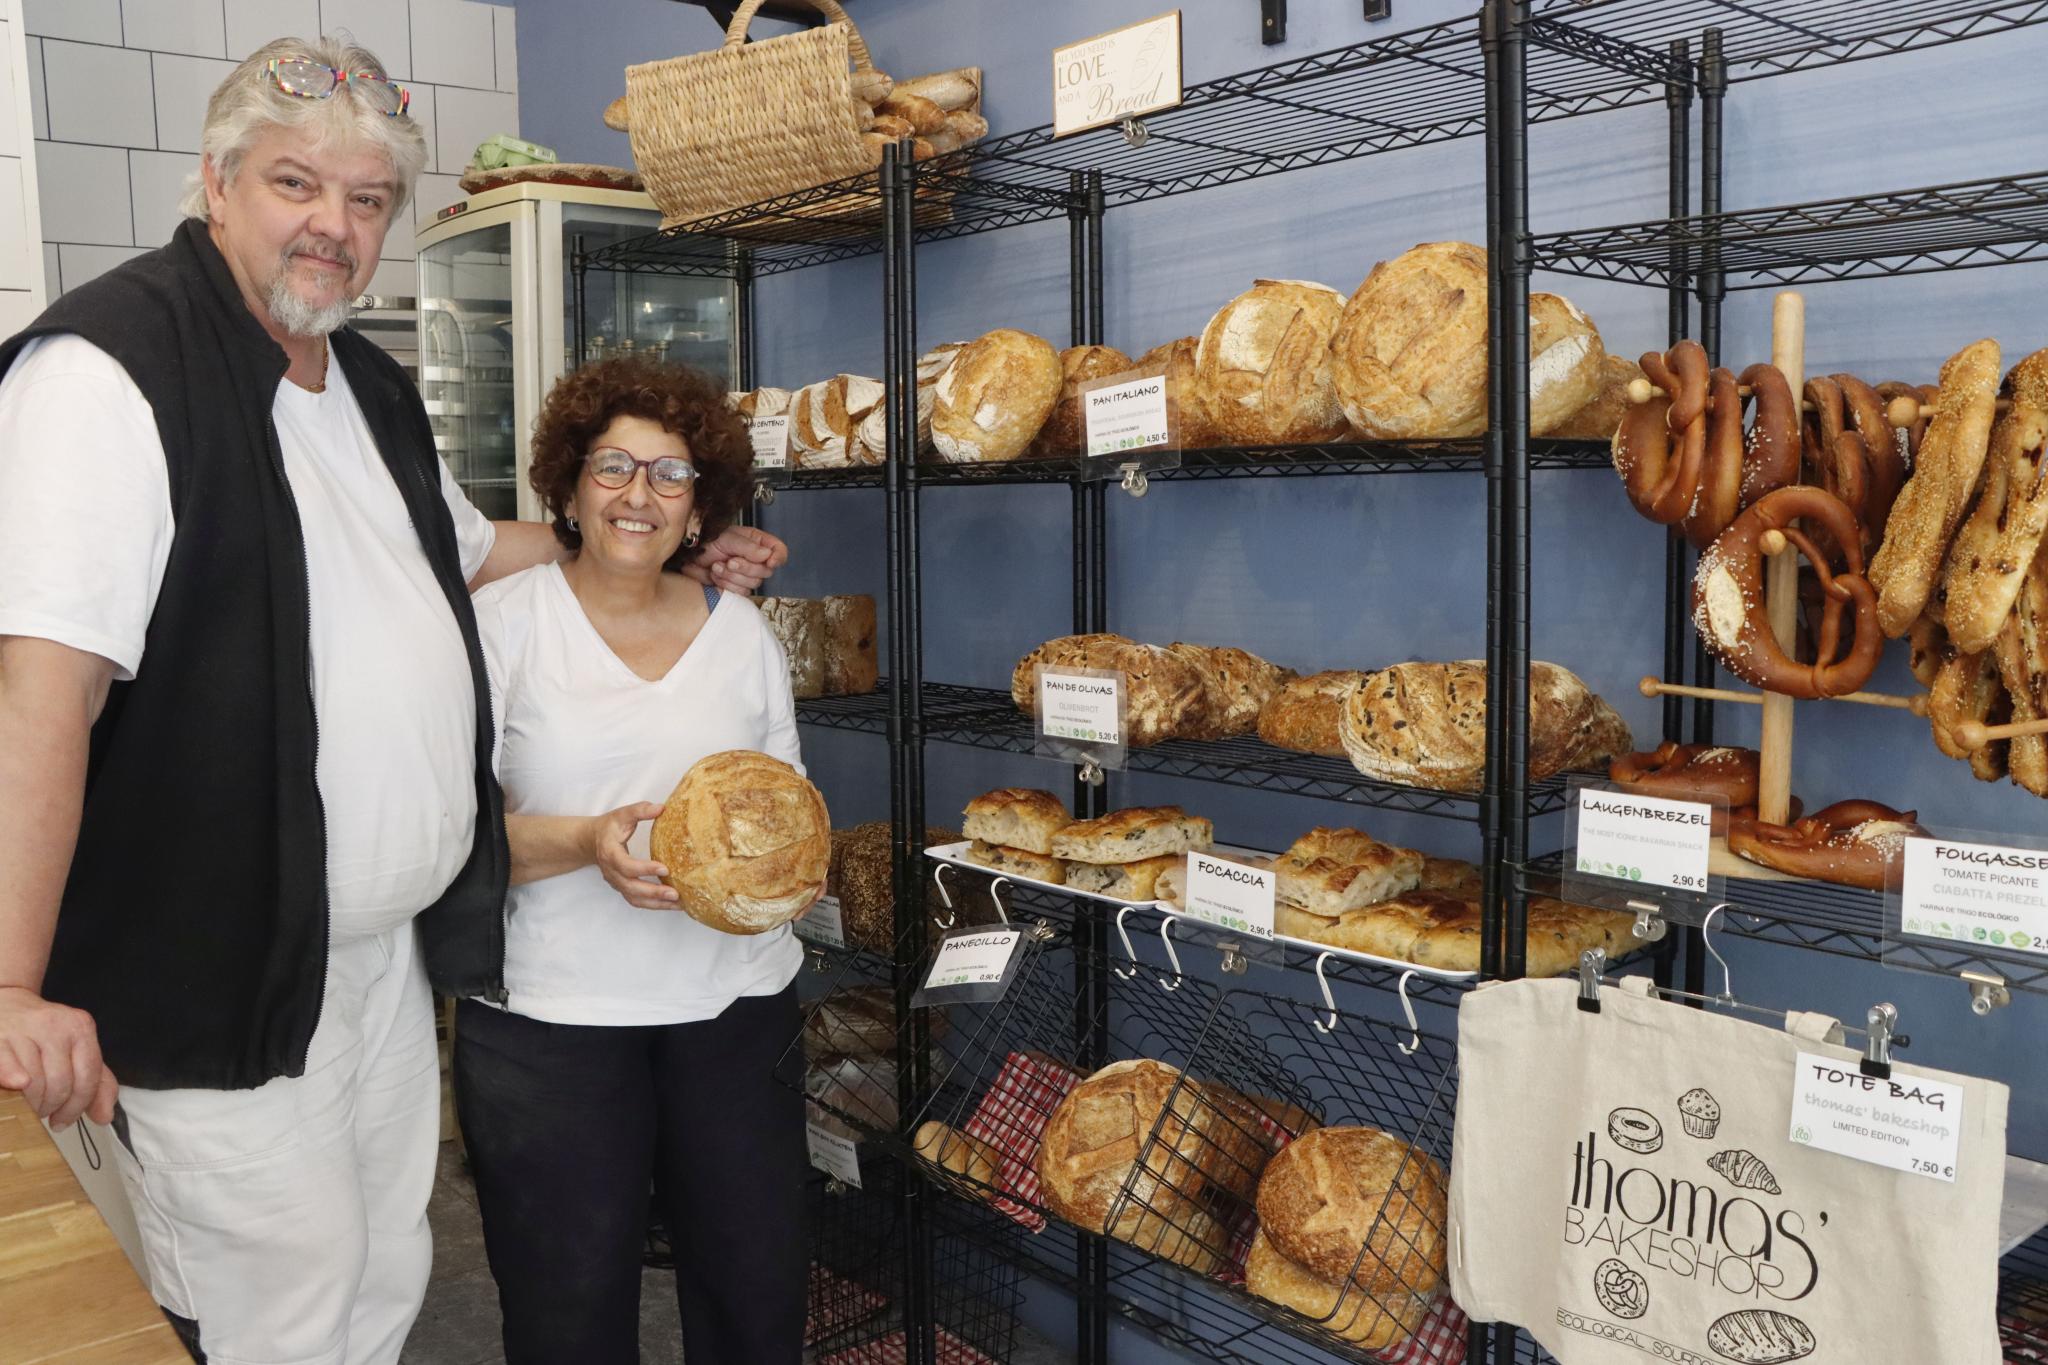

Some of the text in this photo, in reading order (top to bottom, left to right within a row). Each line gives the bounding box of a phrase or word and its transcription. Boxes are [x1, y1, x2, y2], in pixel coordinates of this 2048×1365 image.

[1070, 48, 1085, 61] YOU
[1087, 72, 1163, 121] Bread
[1093, 386, 1159, 406] PAN ITALIANO
[757, 420, 785, 428] CENTENO
[1147, 433, 1159, 443] 4,50
[1046, 681, 1113, 695] PAN DE OLIVAS
[1098, 732, 1111, 741] 5,20
[1583, 800, 1711, 826] LAUGENBREZEL
[1936, 846, 2048, 870] FOUGASSE
[1198, 861, 1265, 889] FOCACCIA
[1672, 874, 1705, 888] 2,90 €
[1943, 867, 2039, 888] TOMATE PICANTE
[1932, 883, 1993, 900] CIABATTA
[1920, 903, 1945, 912] HARINA
[1946, 906, 1955, 914] DE
[1957, 908, 1977, 917] TRIGO
[1250, 925, 1273, 937] 2,90 €
[945, 937, 1011, 951] PANECILLO
[2033, 937, 2048, 950] 2,
[1812, 1065, 1945, 1112] TOTE BAG
[1804, 1092, 1950, 1141] thomas' bakeshop
[1832, 1120, 1910, 1147] LIMITED EDITION
[1911, 1158, 1953, 1178] 7,50 €
[1572, 1131, 1828, 1301] thomas'
[1564, 1206, 1784, 1300] BAKESHOP
[1556, 1309, 1646, 1349] ECOLOGICAL
